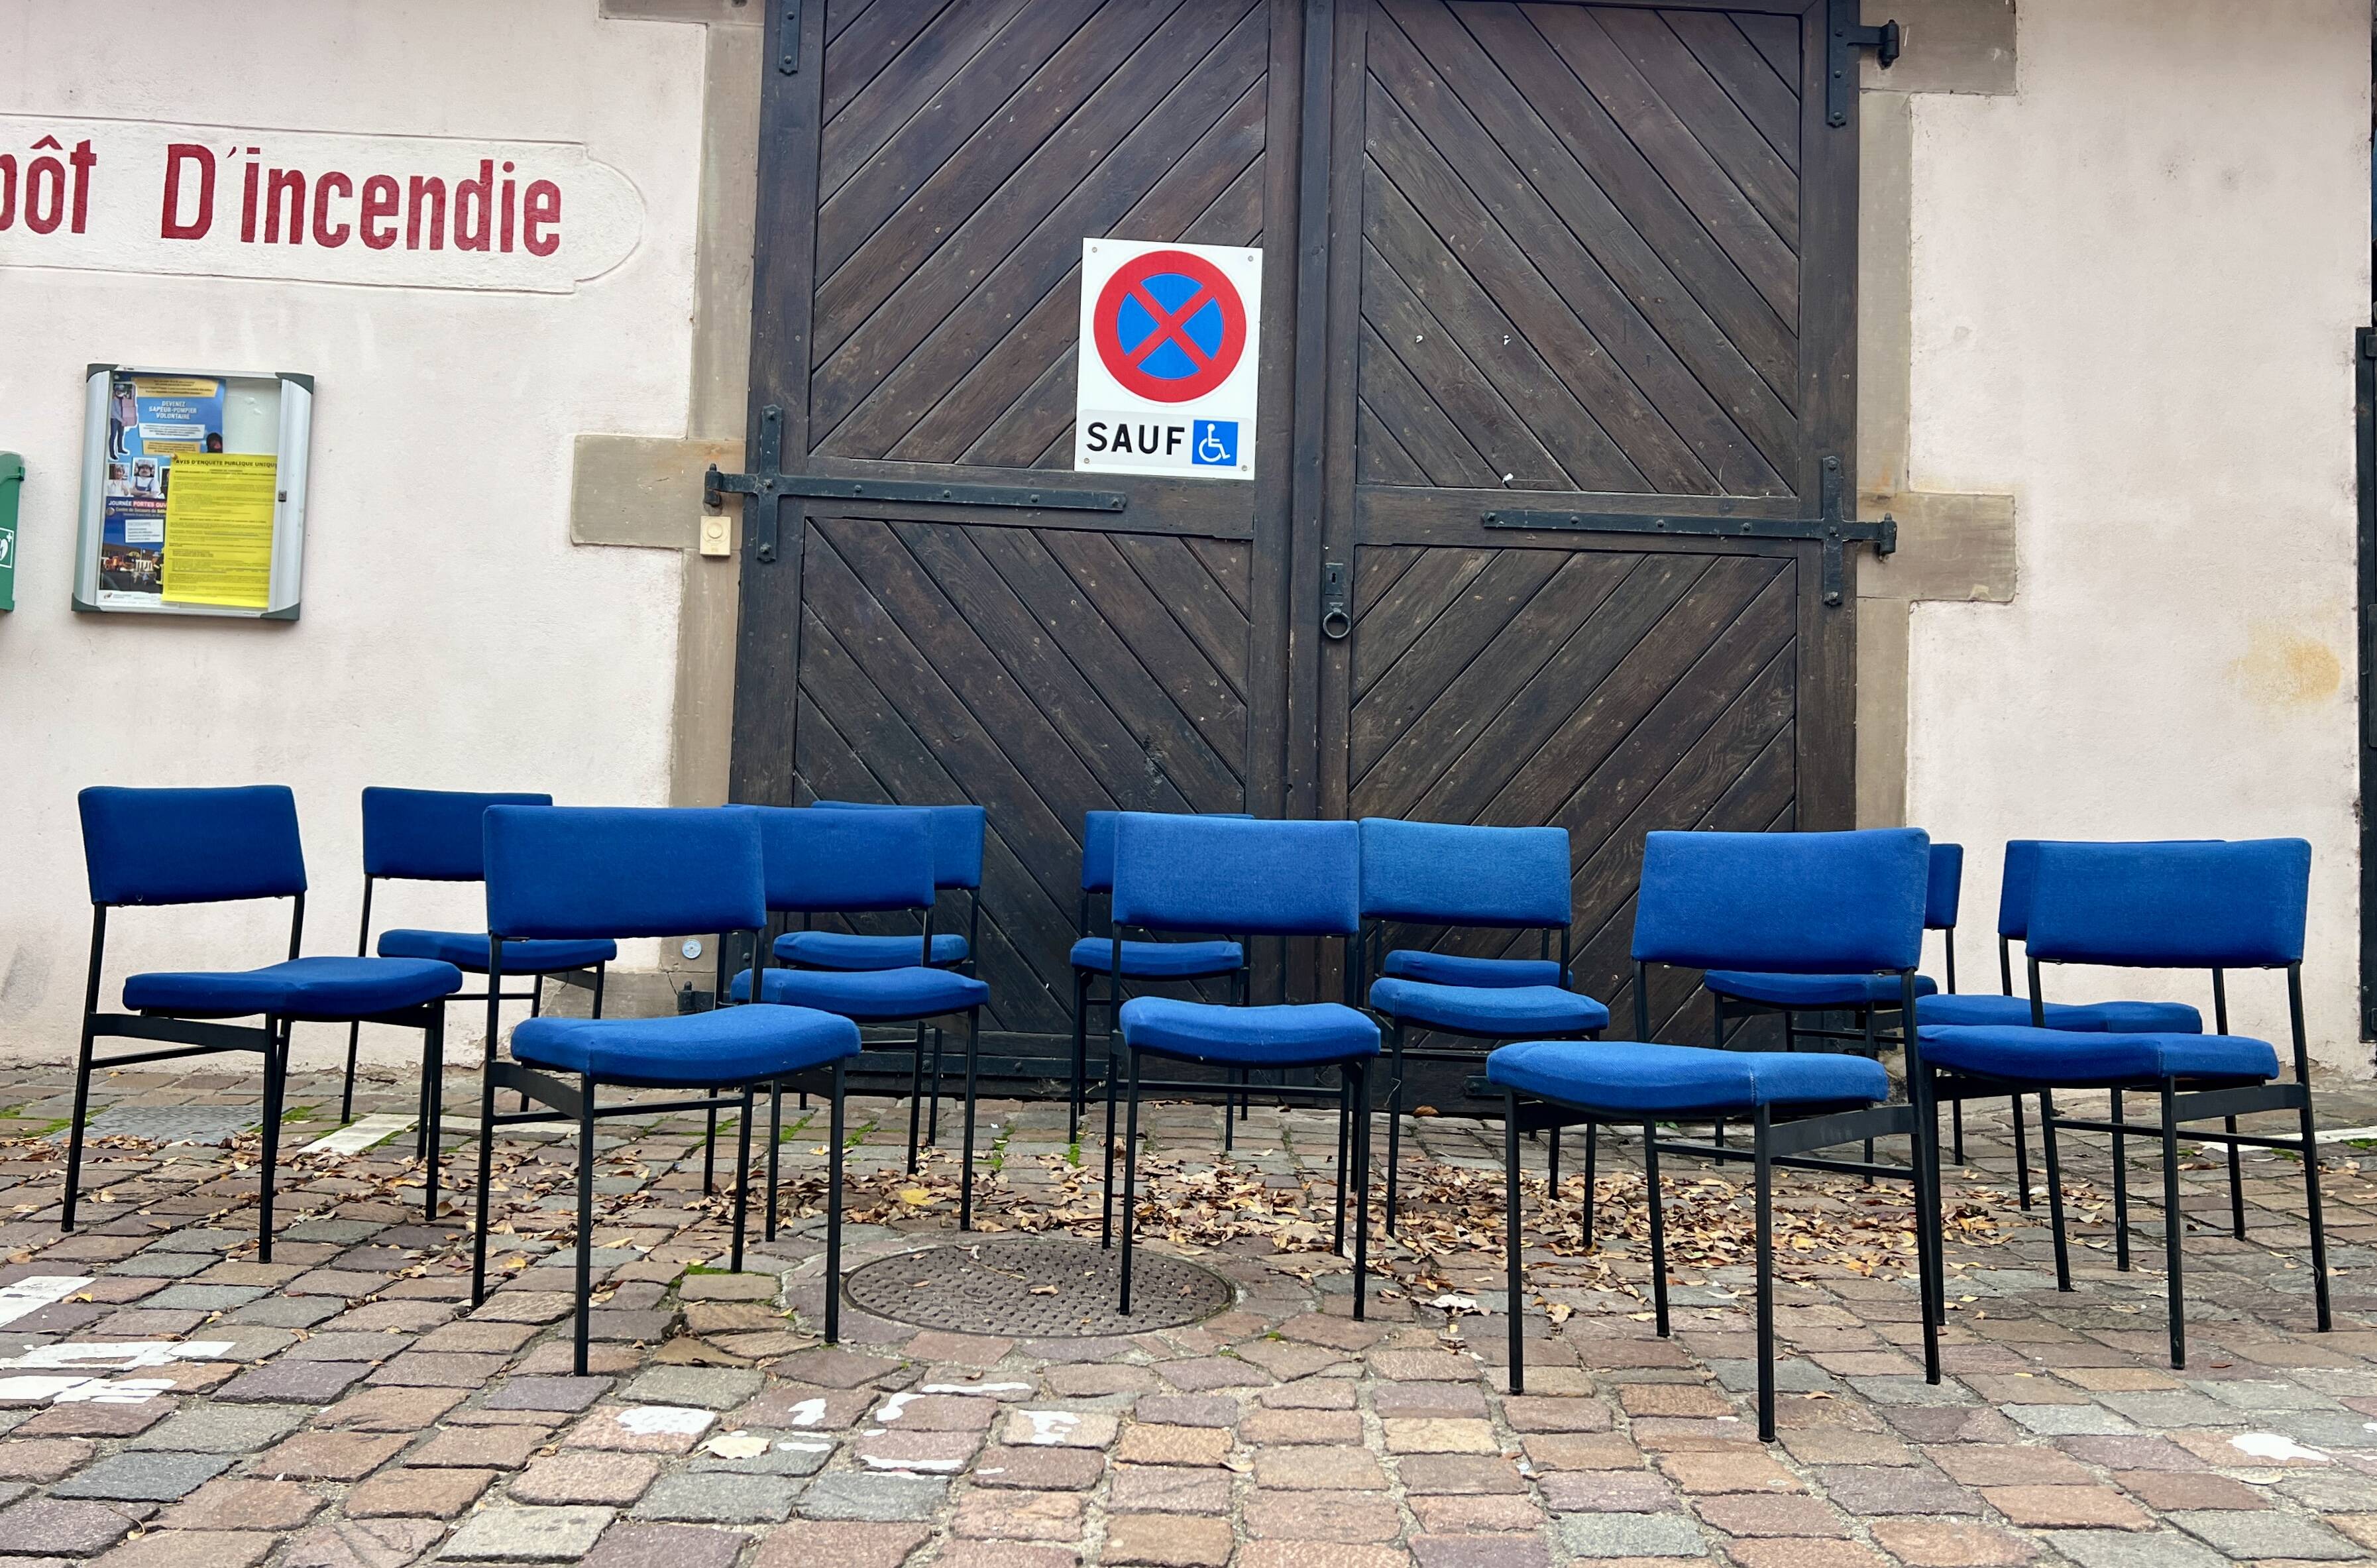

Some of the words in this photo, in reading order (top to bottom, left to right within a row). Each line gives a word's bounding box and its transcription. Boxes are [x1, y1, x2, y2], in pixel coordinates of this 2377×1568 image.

[161, 143, 561, 256] D'incendie
[148, 406, 197, 414] SAPEUR-POMPIER
[1086, 421, 1185, 455] SAUF
